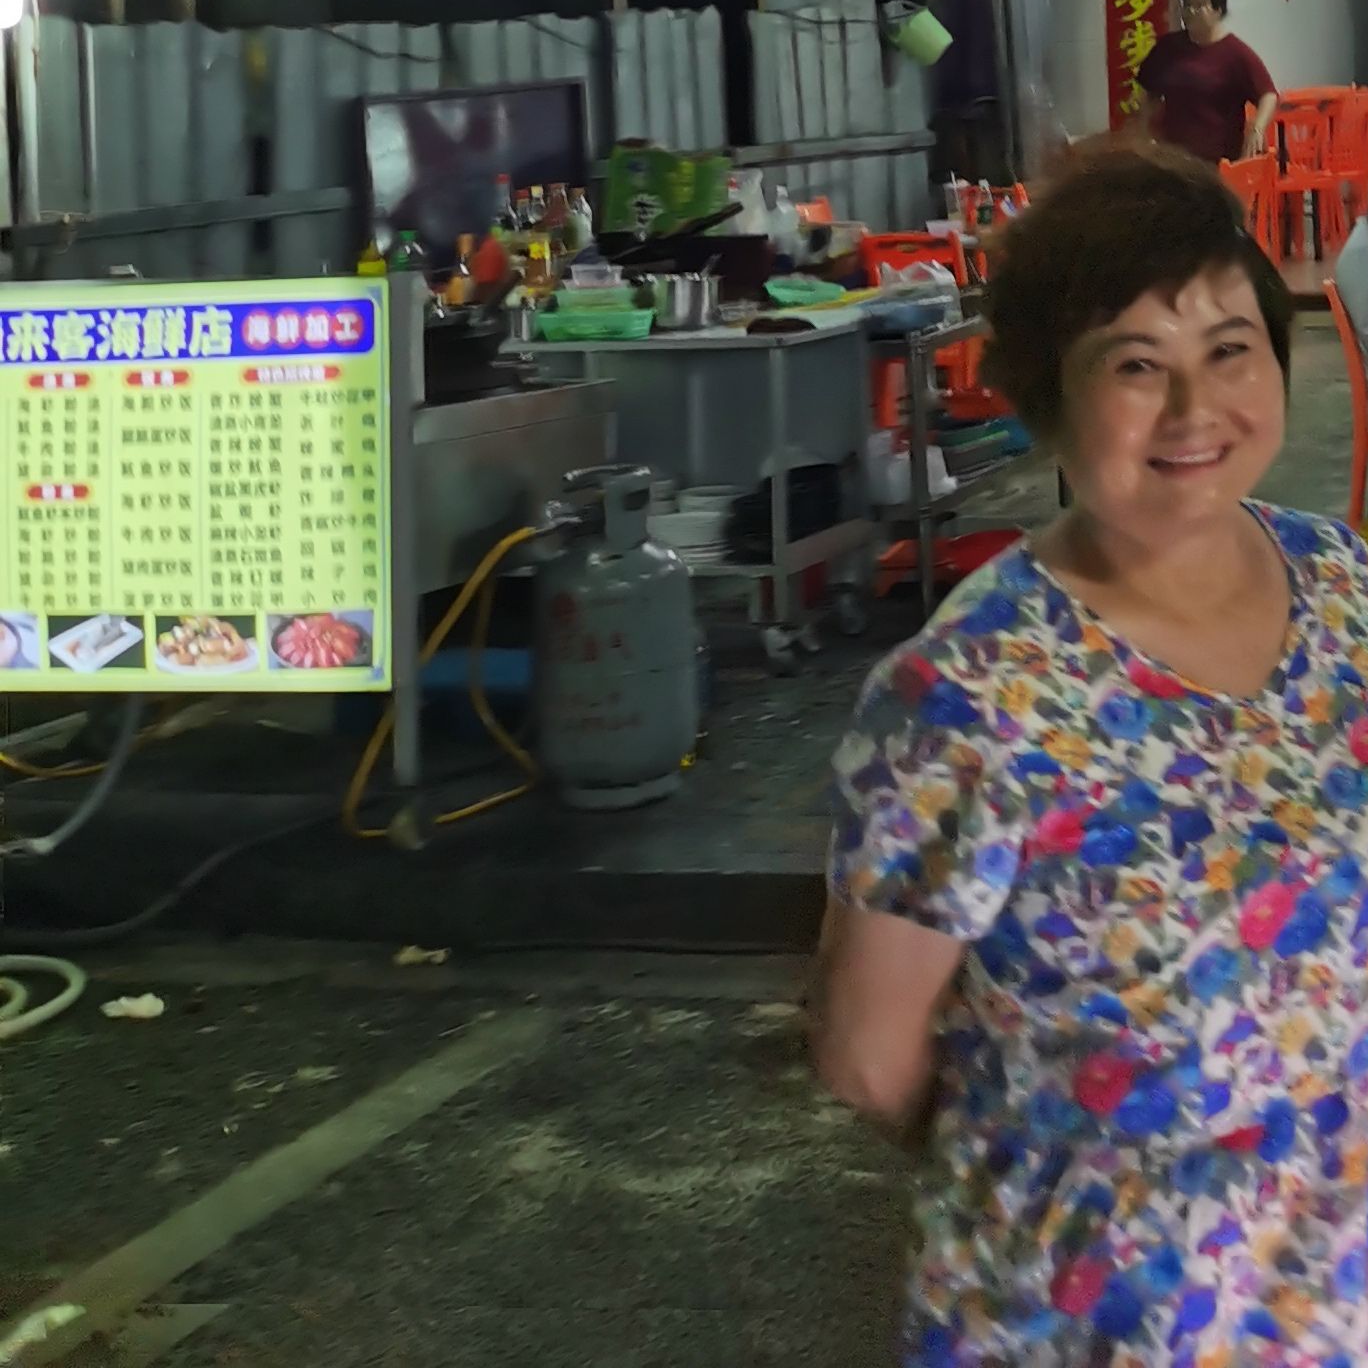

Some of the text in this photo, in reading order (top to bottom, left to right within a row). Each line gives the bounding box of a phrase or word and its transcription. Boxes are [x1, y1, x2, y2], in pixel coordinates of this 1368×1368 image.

[0, 305, 233, 361] 来客海鲜店
